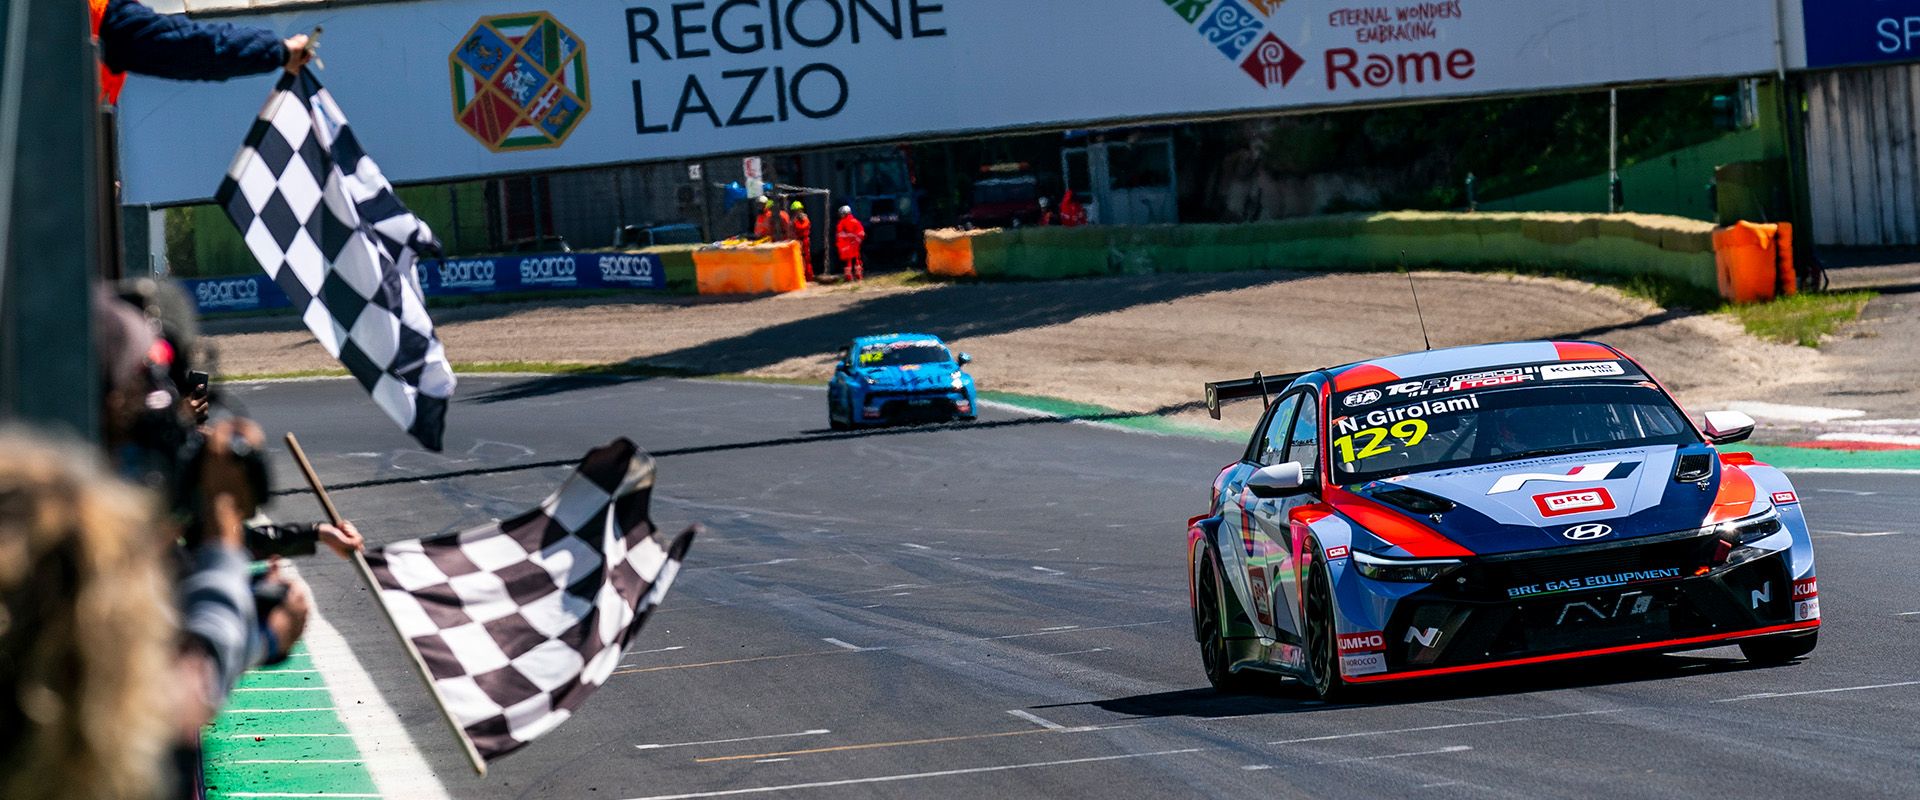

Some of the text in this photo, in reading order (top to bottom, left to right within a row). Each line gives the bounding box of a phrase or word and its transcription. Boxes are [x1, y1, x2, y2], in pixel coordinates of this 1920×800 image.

[1328, 0, 1462, 27] ETERNAL WONDERS
[625, 0, 947, 63] REGIONE
[1355, 21, 1437, 43] EMBRACING
[1324, 47, 1476, 91] Rome
[631, 62, 849, 135] LAZIO
[520, 256, 576, 279] sparco
[599, 255, 651, 277] sparco
[196, 278, 259, 302] sparco
[1455, 368, 1522, 381] WORLD
[1550, 364, 1612, 374] KUMHO
[1386, 377, 1449, 396] TCR
[1465, 374, 1535, 388] TOUR
[1345, 390, 1378, 405] FIA
[1337, 393, 1480, 435] N.Girolami
[1333, 418, 1429, 464] 129
[1552, 495, 1594, 505] BRC
[1507, 567, 1681, 597] BRC GAS EQUIPMENT
